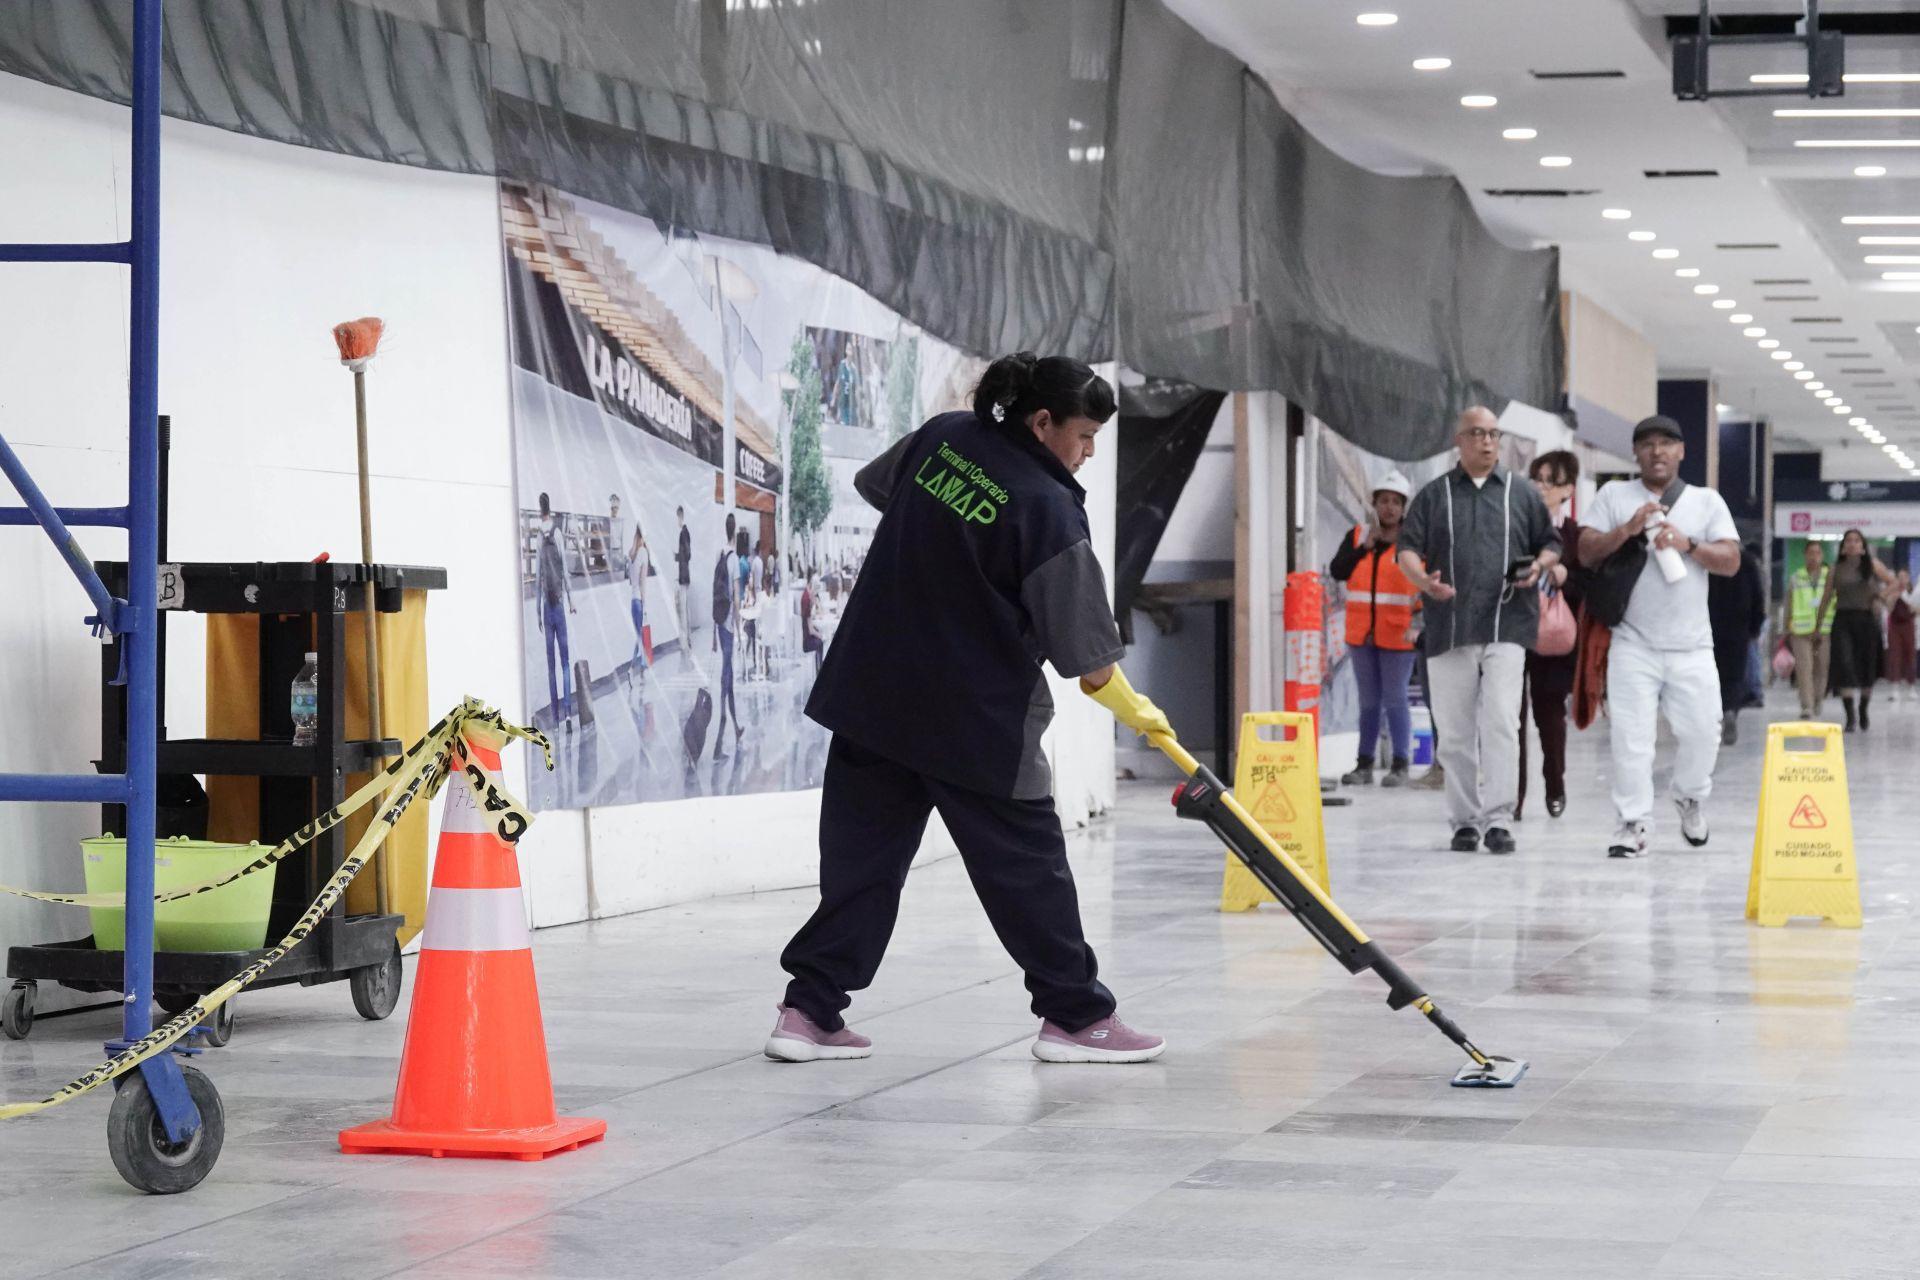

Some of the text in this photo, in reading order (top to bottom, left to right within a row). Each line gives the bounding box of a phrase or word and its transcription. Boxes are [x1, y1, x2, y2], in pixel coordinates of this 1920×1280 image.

[586, 334, 615, 396] LA
[937, 441, 972, 472] Terminal
[970, 467, 1009, 504] Operario
[1784, 766, 1829, 775] CAUTION
[1777, 775, 1835, 783] WET FLOOR
[1785, 841, 1832, 850] CUIDADO
[1775, 850, 1843, 858] PISO MOJADO
